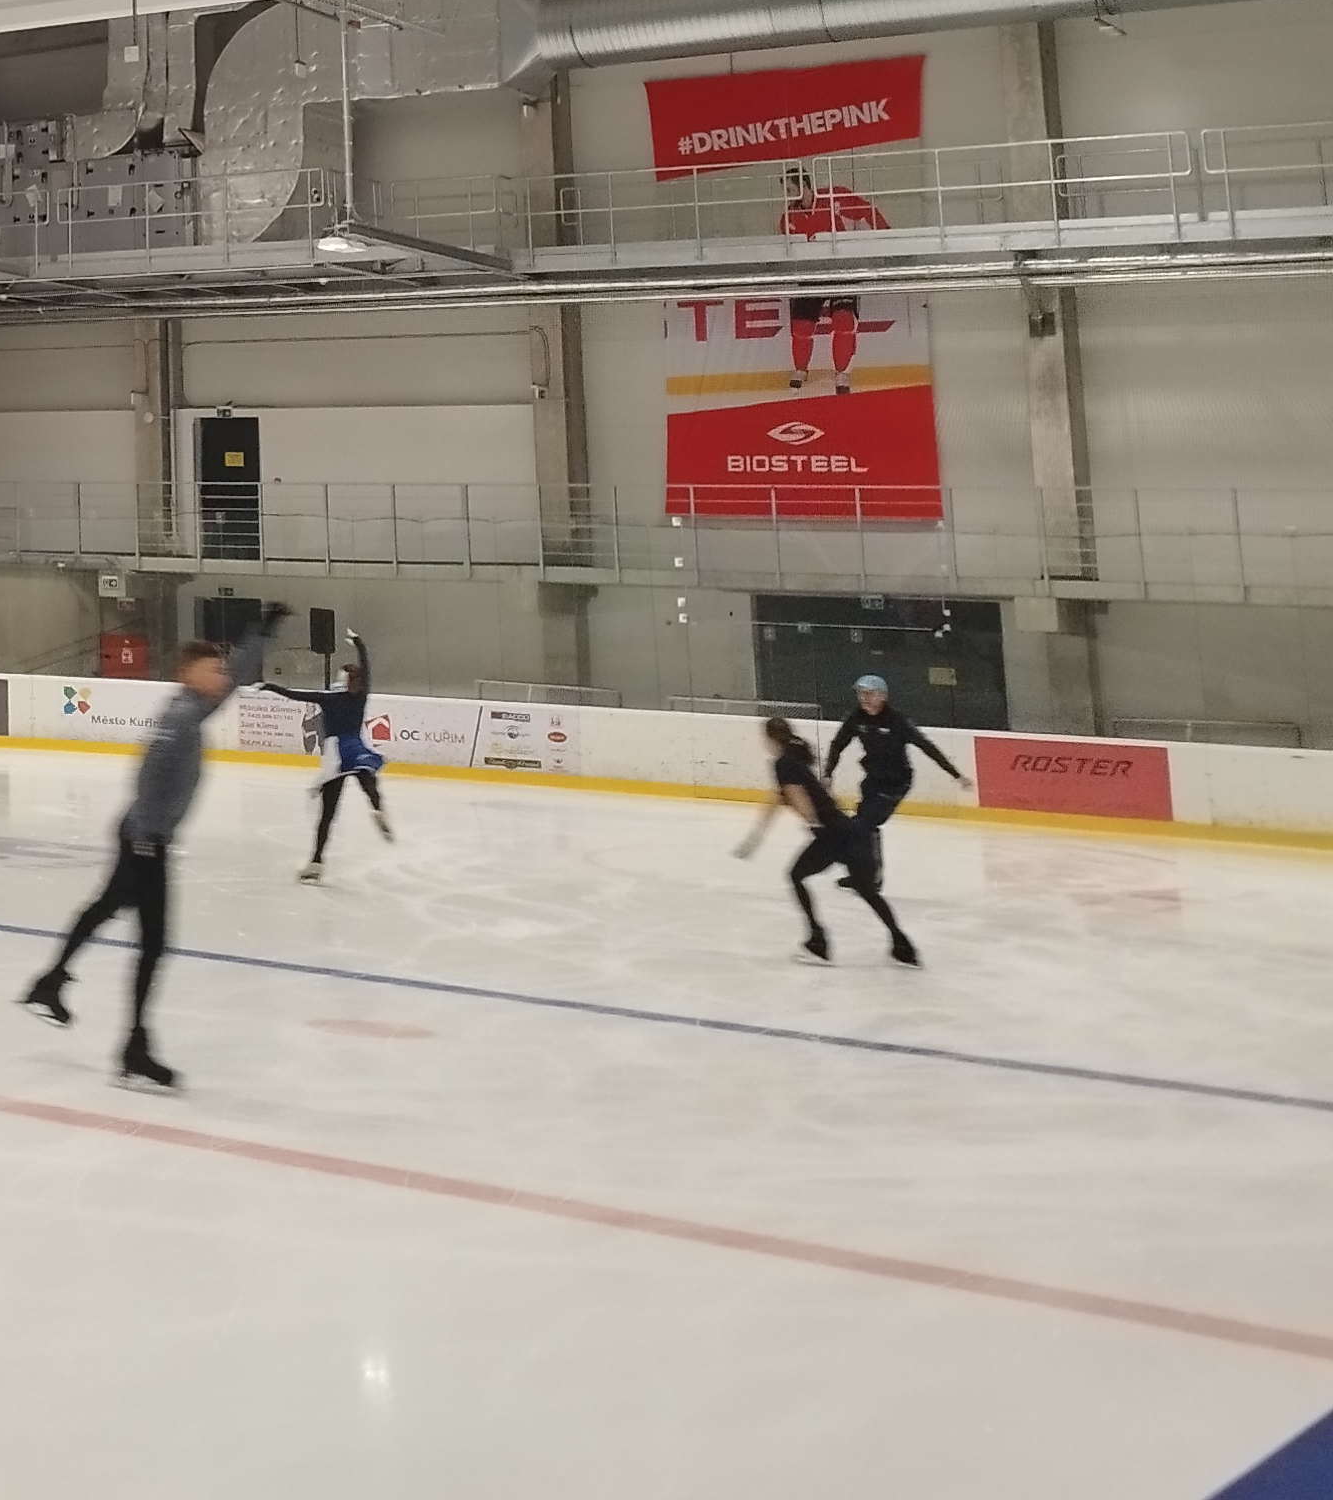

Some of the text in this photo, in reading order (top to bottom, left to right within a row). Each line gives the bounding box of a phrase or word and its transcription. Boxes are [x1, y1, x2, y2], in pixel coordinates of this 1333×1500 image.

[677, 97, 892, 156] #DRINKTHEPINK
[727, 454, 870, 474] BIOSTEEL
[91, 715, 126, 726] Město
[400, 729, 465, 743] OC KUŘIM
[1010, 754, 1133, 776] ROSTER
